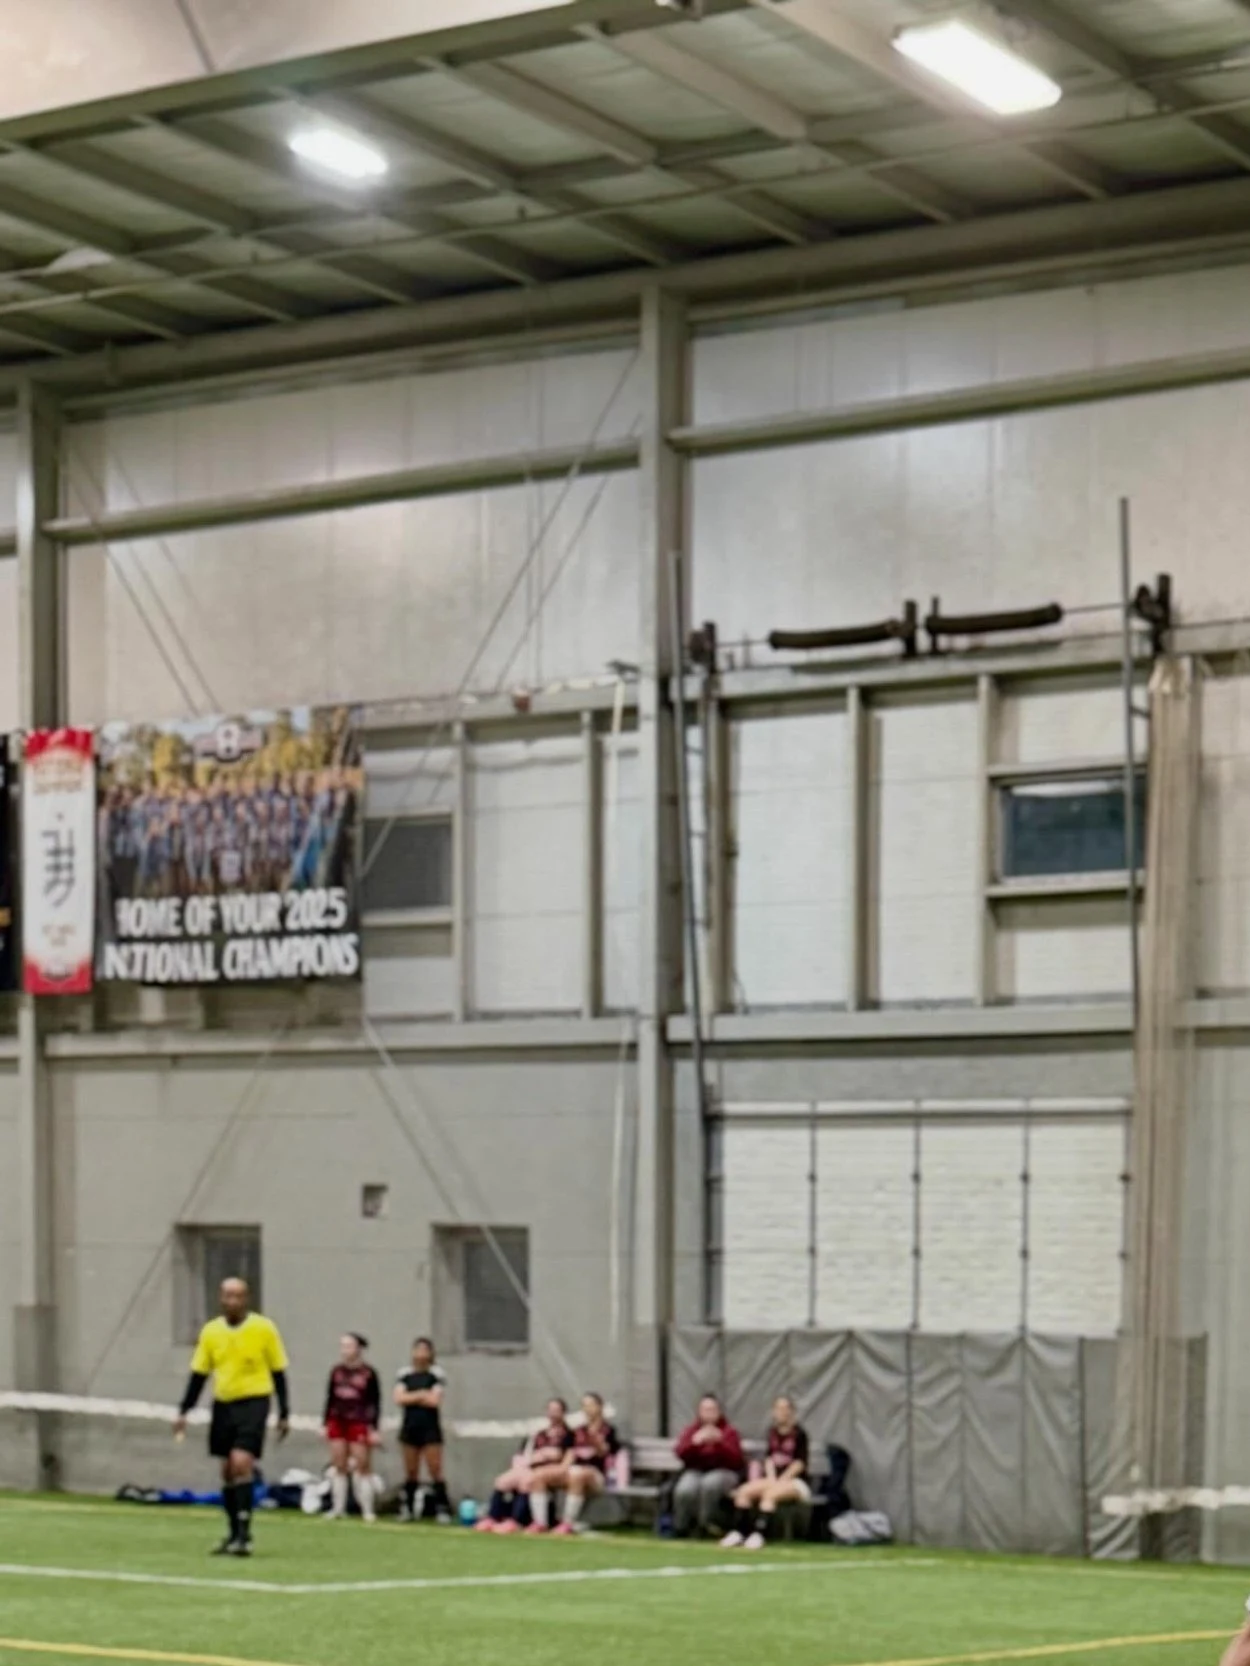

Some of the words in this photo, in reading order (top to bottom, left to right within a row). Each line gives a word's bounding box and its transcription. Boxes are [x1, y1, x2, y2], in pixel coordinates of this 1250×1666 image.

[185, 895, 217, 936] OF
[219, 891, 282, 935] YOUR
[284, 887, 348, 931] 2025
[104, 941, 220, 982] NTIONAL
[222, 933, 360, 981] CHAMPIONS
